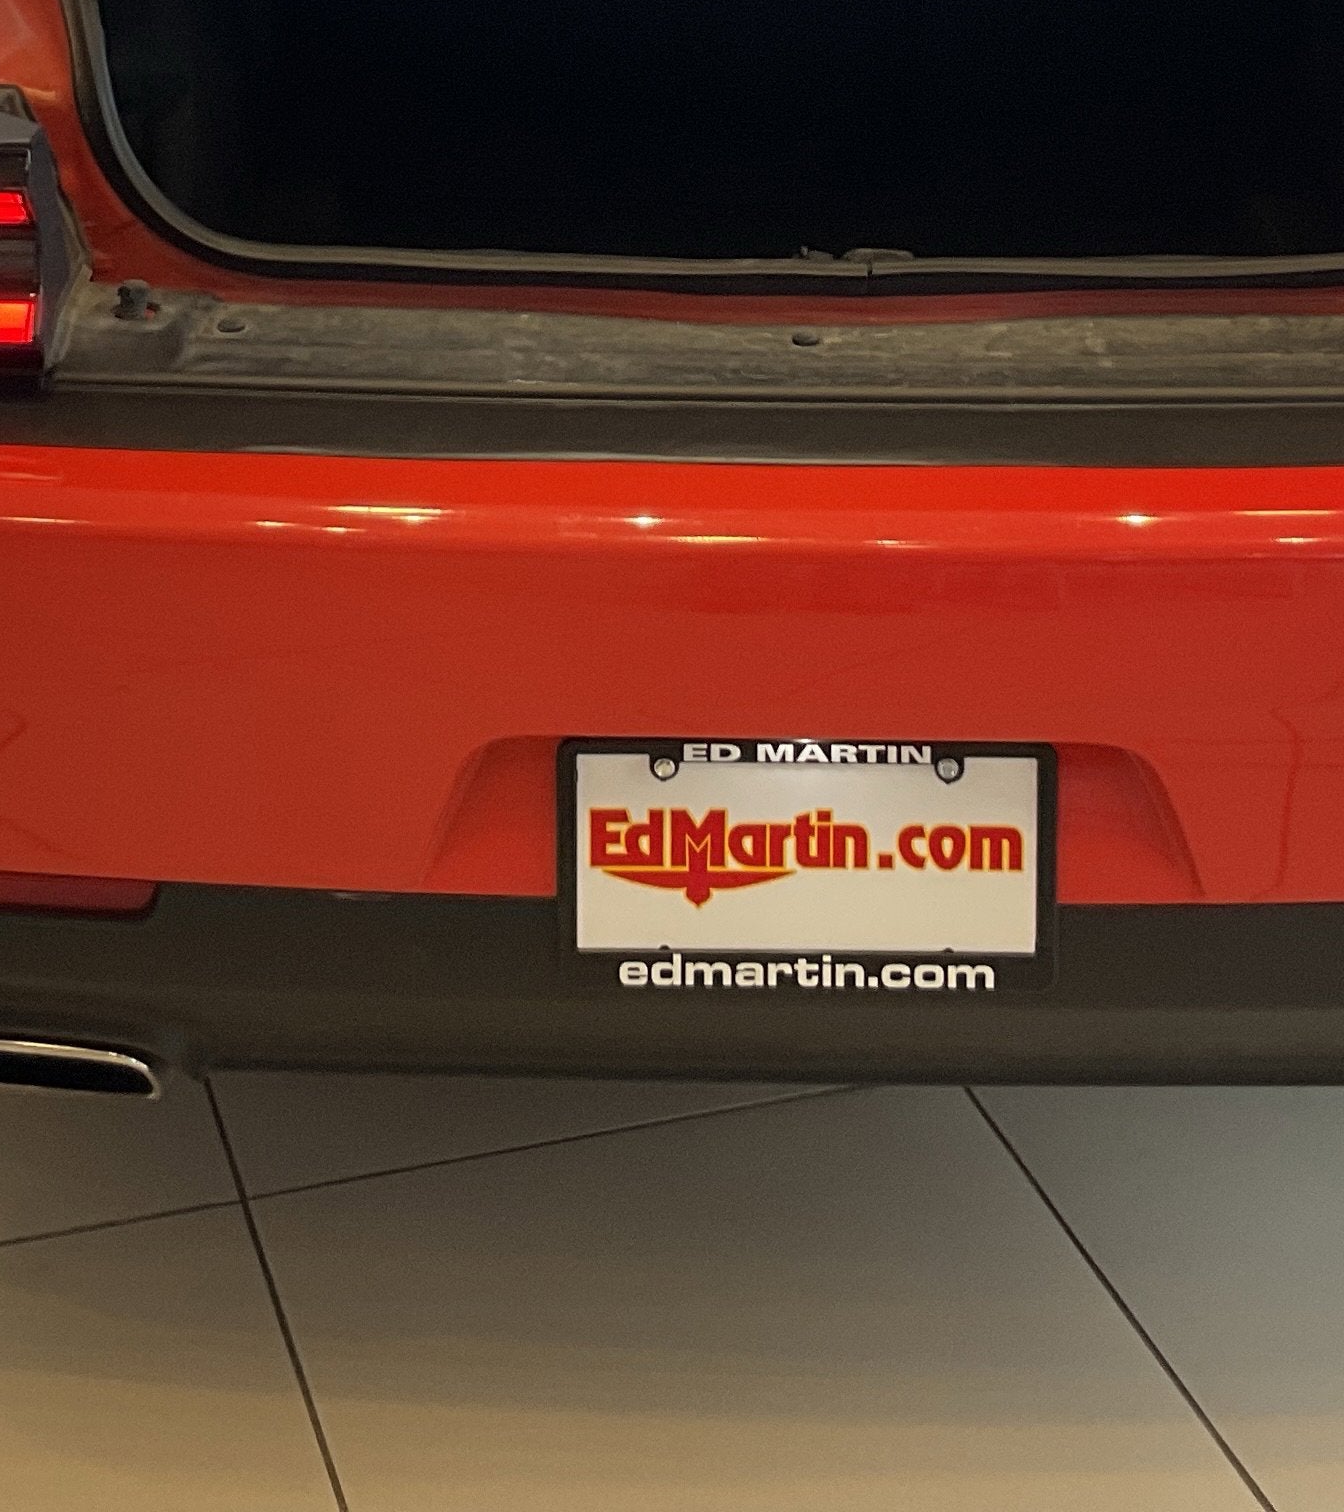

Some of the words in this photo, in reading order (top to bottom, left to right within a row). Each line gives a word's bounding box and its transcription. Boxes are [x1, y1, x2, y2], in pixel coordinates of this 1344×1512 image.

[683, 743, 741, 762] ED
[757, 743, 932, 765] MARTIN
[589, 807, 1023, 873] EdMartin.com
[619, 953, 995, 990] edmartin.com
